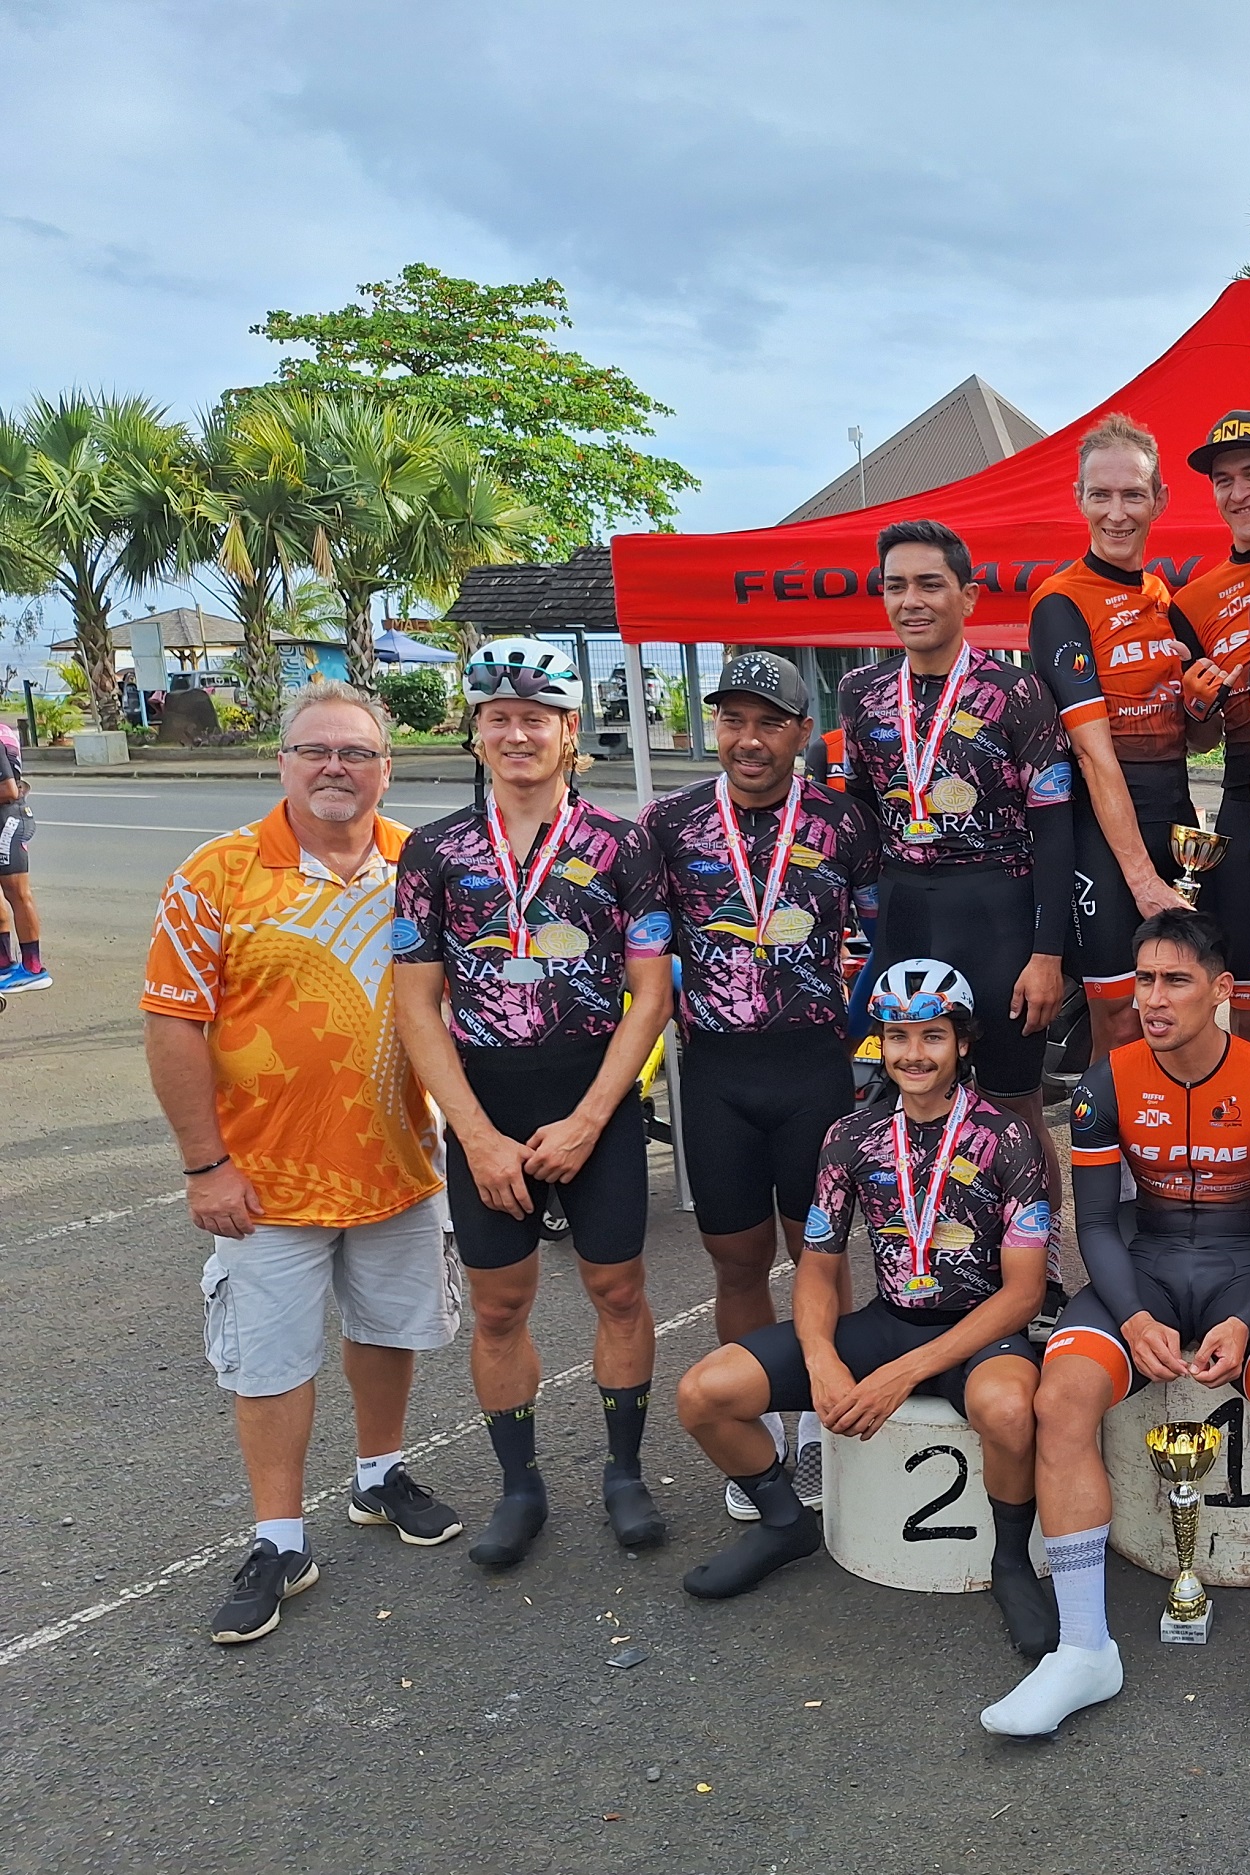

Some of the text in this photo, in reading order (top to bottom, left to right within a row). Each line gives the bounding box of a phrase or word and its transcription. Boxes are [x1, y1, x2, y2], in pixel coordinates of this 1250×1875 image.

[1105, 594, 1128, 606] DIFFU
[1219, 581, 1244, 599] DIFFU
[1109, 637, 1178, 668] AS PIR
[1213, 629, 1250, 657] AS
[1118, 704, 1162, 717] NIUHITI
[690, 937, 827, 967] VAERA'I
[457, 954, 607, 979] VARA'I
[144, 979, 198, 1004] ALEUR
[688, 990, 730, 1034] OROHE
[458, 1008, 501, 1048] OROHE
[1142, 1092, 1165, 1101] DIFFU
[1129, 1144, 1248, 1163] AS PIRAE
[902, 1444, 978, 1542] 2
